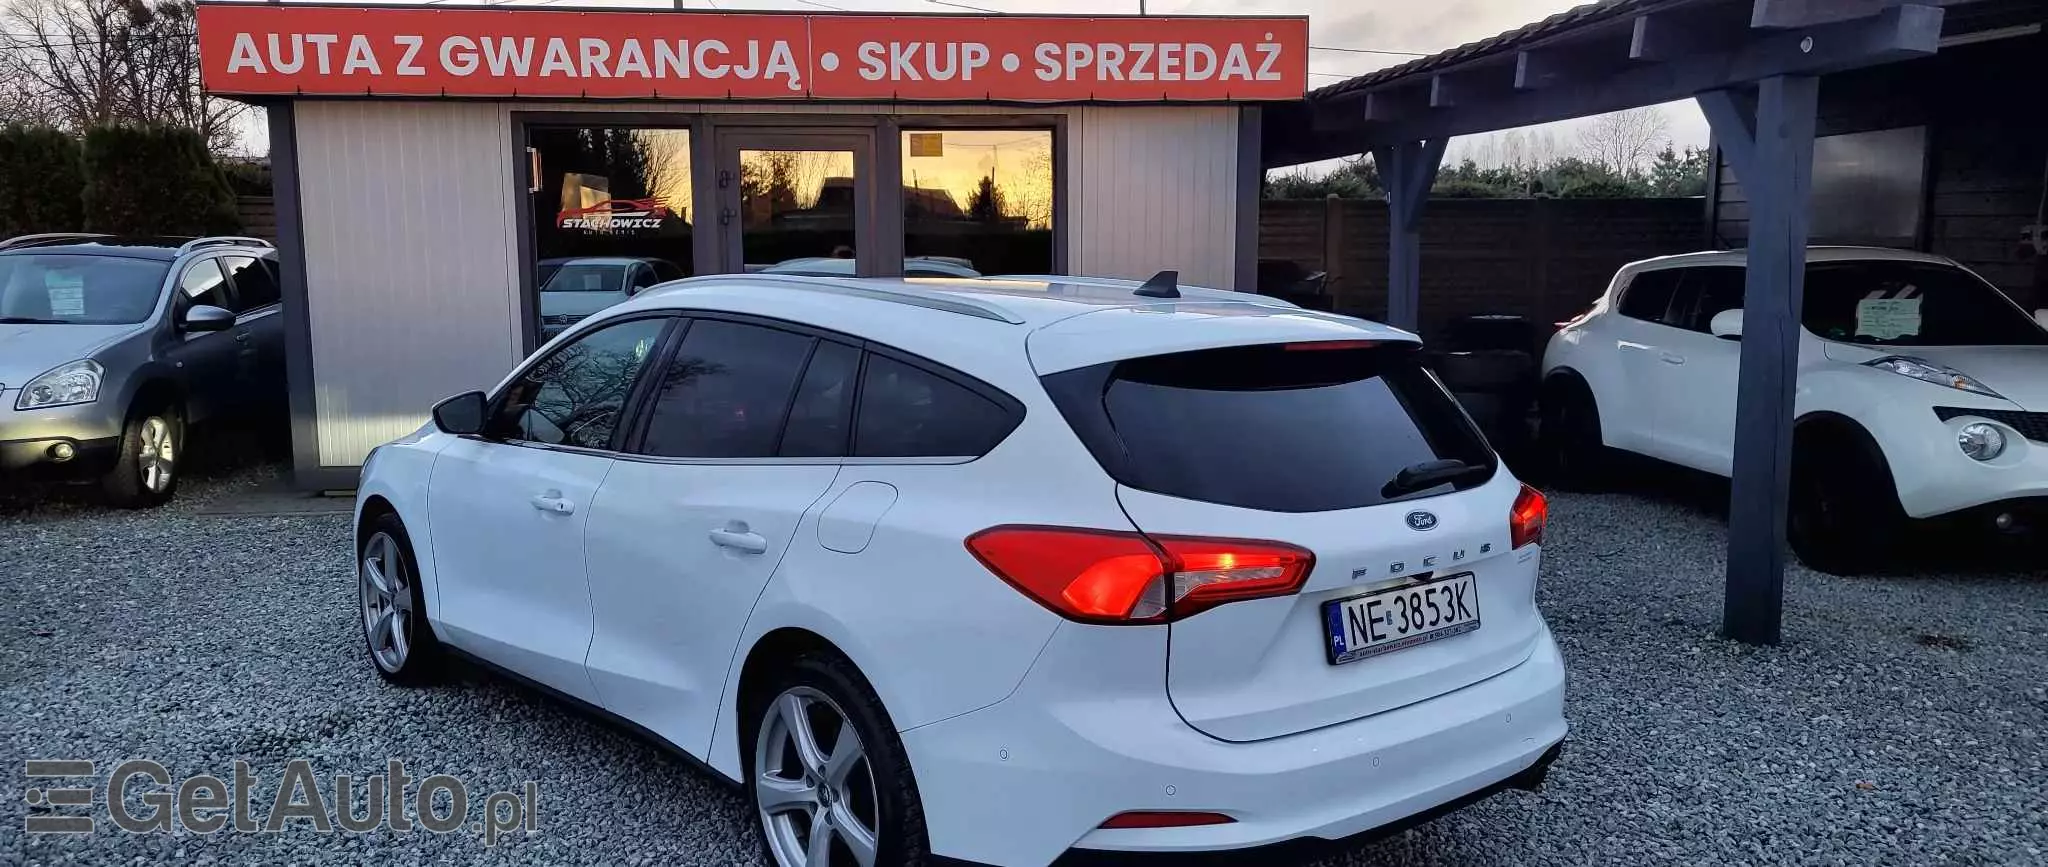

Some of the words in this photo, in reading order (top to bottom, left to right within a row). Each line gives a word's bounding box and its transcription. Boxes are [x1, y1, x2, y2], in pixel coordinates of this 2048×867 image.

[227, 33, 381, 75] AUTA
[394, 36, 425, 76] Z
[439, 36, 801, 91] GWARANCJĄ
[858, 41, 990, 81] SKUP
[1034, 32, 1283, 81] SPRZEDAŻ
[562, 218, 662, 229] STACHOWICZ
[1351, 543, 1491, 578] FOCUS
[1348, 600, 1386, 646] NE
[1394, 581, 1472, 634] 3853K
[1333, 635, 1345, 647] PL
